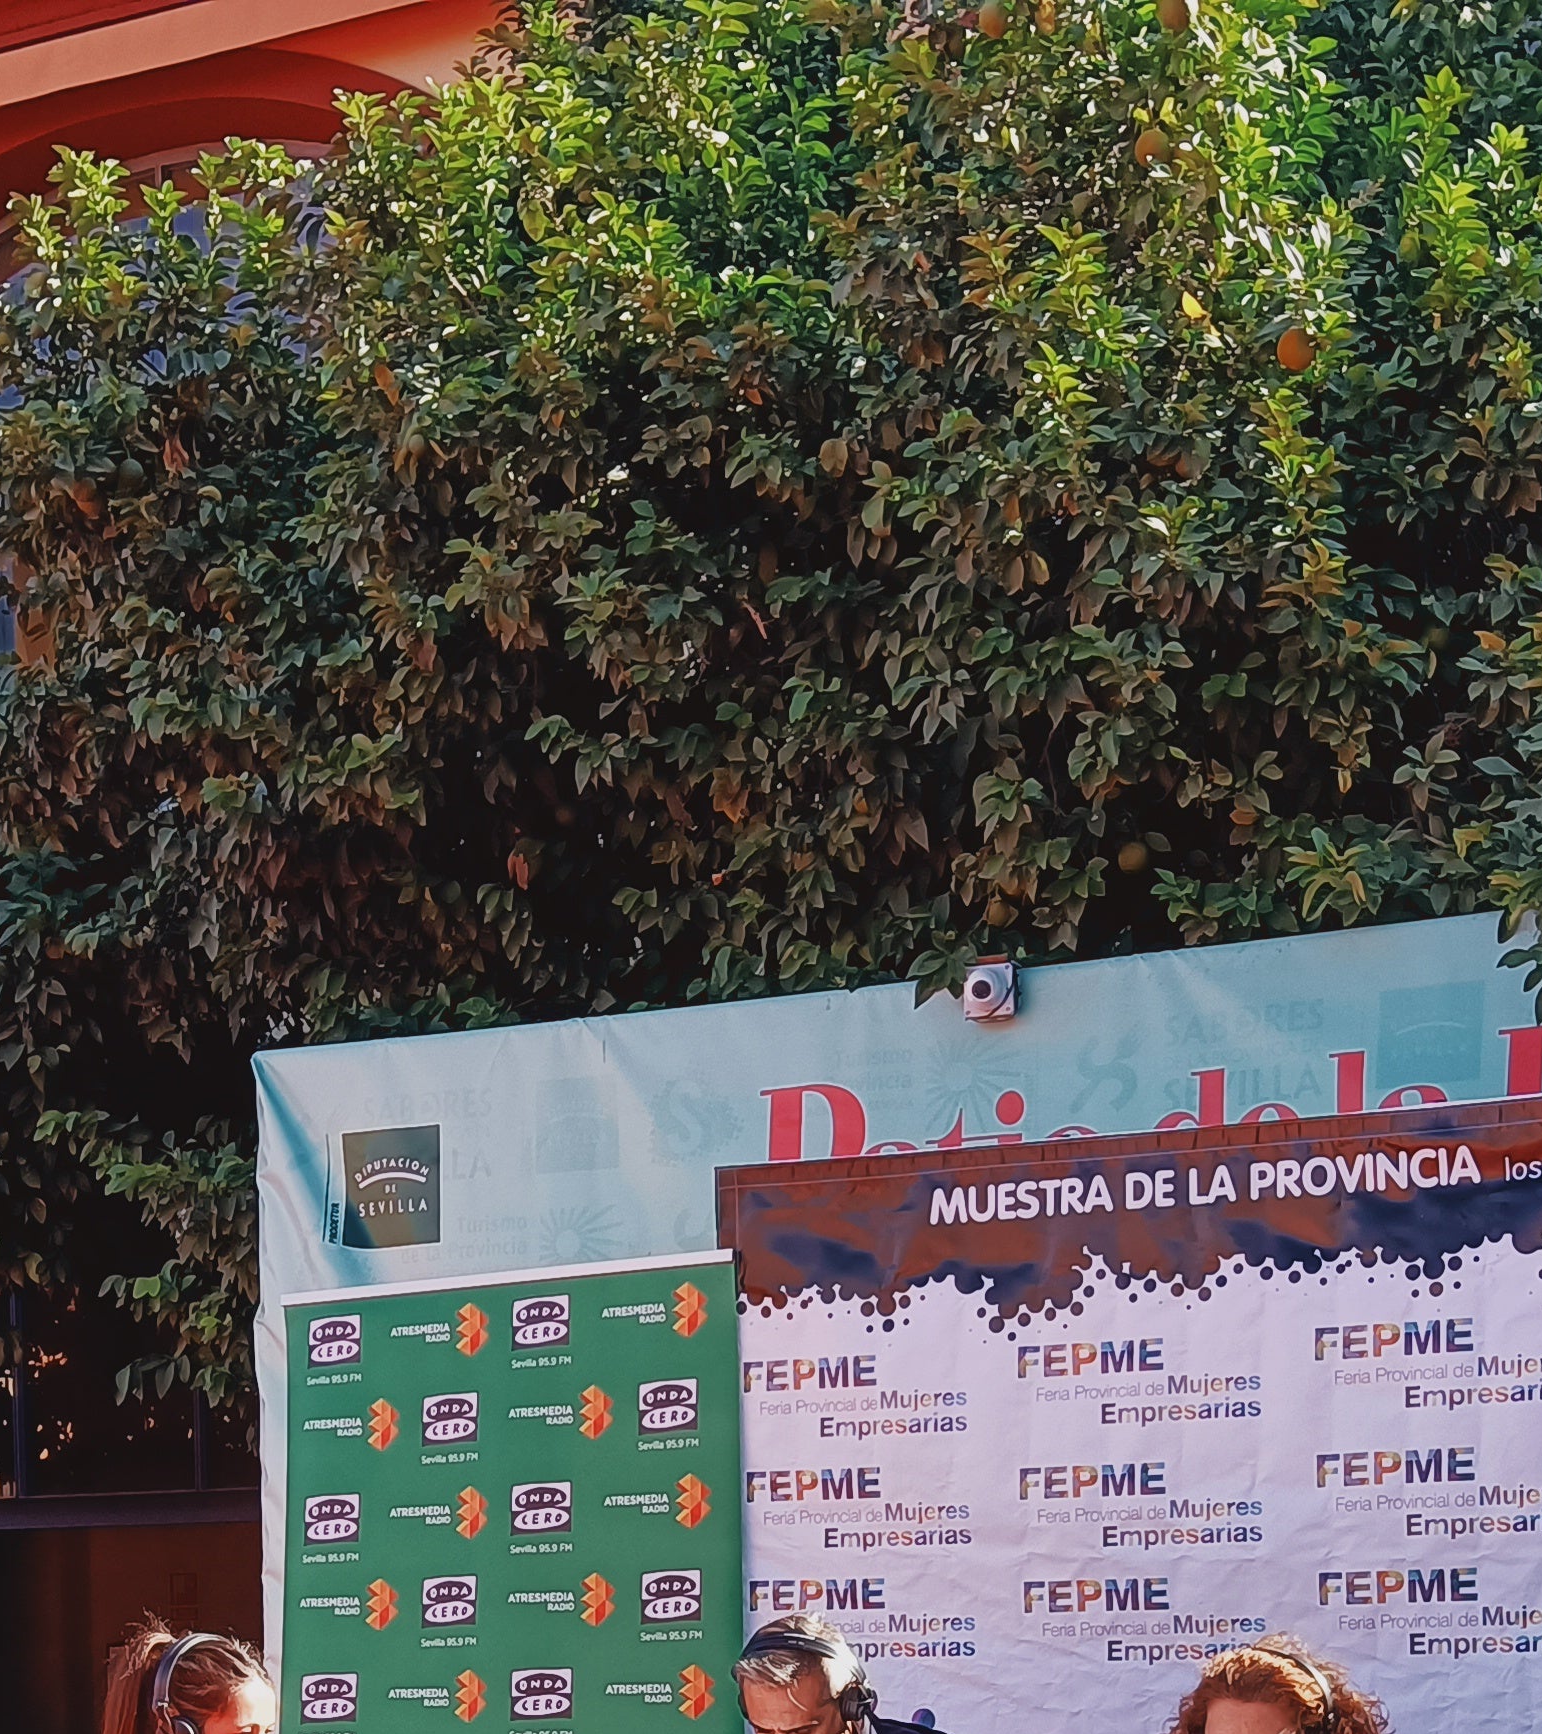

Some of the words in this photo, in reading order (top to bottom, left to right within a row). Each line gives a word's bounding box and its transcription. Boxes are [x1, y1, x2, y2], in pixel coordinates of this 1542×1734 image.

[354, 1157, 429, 1183] DIPUTACION
[385, 1184, 396, 1193] DE
[929, 1175, 1114, 1226] MUESTRA
[1125, 1169, 1176, 1210] DE
[1188, 1164, 1237, 1206] LA
[1250, 1145, 1482, 1201] PROVINCIA
[1504, 1156, 1542, 1182] los
[359, 1199, 427, 1217] SEVILLA
[329, 1203, 340, 1244] PRODETUR
[519, 1305, 561, 1319] ONDA
[602, 1303, 667, 1318] ATRESMEDIA
[638, 1312, 667, 1324] RADIO
[315, 1325, 353, 1339] ONDA
[391, 1323, 451, 1337] ATRESMEDIA
[521, 1324, 561, 1341] CERO
[426, 1334, 451, 1343] RADIO
[1314, 1317, 1474, 1362] FEPME
[317, 1343, 352, 1357] CERO
[512, 1358, 536, 1369] Sevilla
[538, 1357, 557, 1367] 95.9
[559, 1356, 572, 1365] FM
[742, 1354, 877, 1394] FEPME
[1334, 1369, 1371, 1386] Feria
[1375, 1363, 1448, 1383] Provincial
[1452, 1362, 1475, 1379] de
[645, 1389, 689, 1403] ONDA
[759, 1400, 792, 1416] Feria
[795, 1397, 857, 1414] Provincial
[860, 1396, 882, 1412] de
[880, 1390, 967, 1412] Mujeres
[430, 1402, 470, 1416] ONDA
[508, 1406, 573, 1418] ATRESMEDIA
[546, 1416, 574, 1425] RADIO
[648, 1409, 689, 1424] CERO
[304, 1418, 363, 1431] ATRESMEDIA
[432, 1421, 471, 1436] CERO
[820, 1415, 968, 1441] Empresarias
[337, 1427, 363, 1437] RADIO
[638, 1440, 665, 1451] Sevilla
[667, 1439, 685, 1449] 95.9
[687, 1438, 699, 1448] FM
[1019, 1462, 1167, 1501] FEPME
[1036, 1508, 1071, 1524] Feria
[1074, 1505, 1143, 1523] Provincial
[1146, 1505, 1167, 1521] de
[1169, 1498, 1263, 1522] Mujeres
[1102, 1525, 1263, 1551] Empresarias
[1318, 1567, 1479, 1606] FEPME
[1338, 1614, 1377, 1631] Feria
[1380, 1612, 1453, 1630] Provincial
[1457, 1611, 1479, 1628] de
[308, 1682, 349, 1694] ONDA
[519, 1677, 564, 1691] ONDA
[606, 1684, 672, 1695] ATRESMEDIA
[521, 1697, 563, 1710] CERO
[645, 1694, 672, 1703] RADIO
[310, 1702, 348, 1714] CERO
